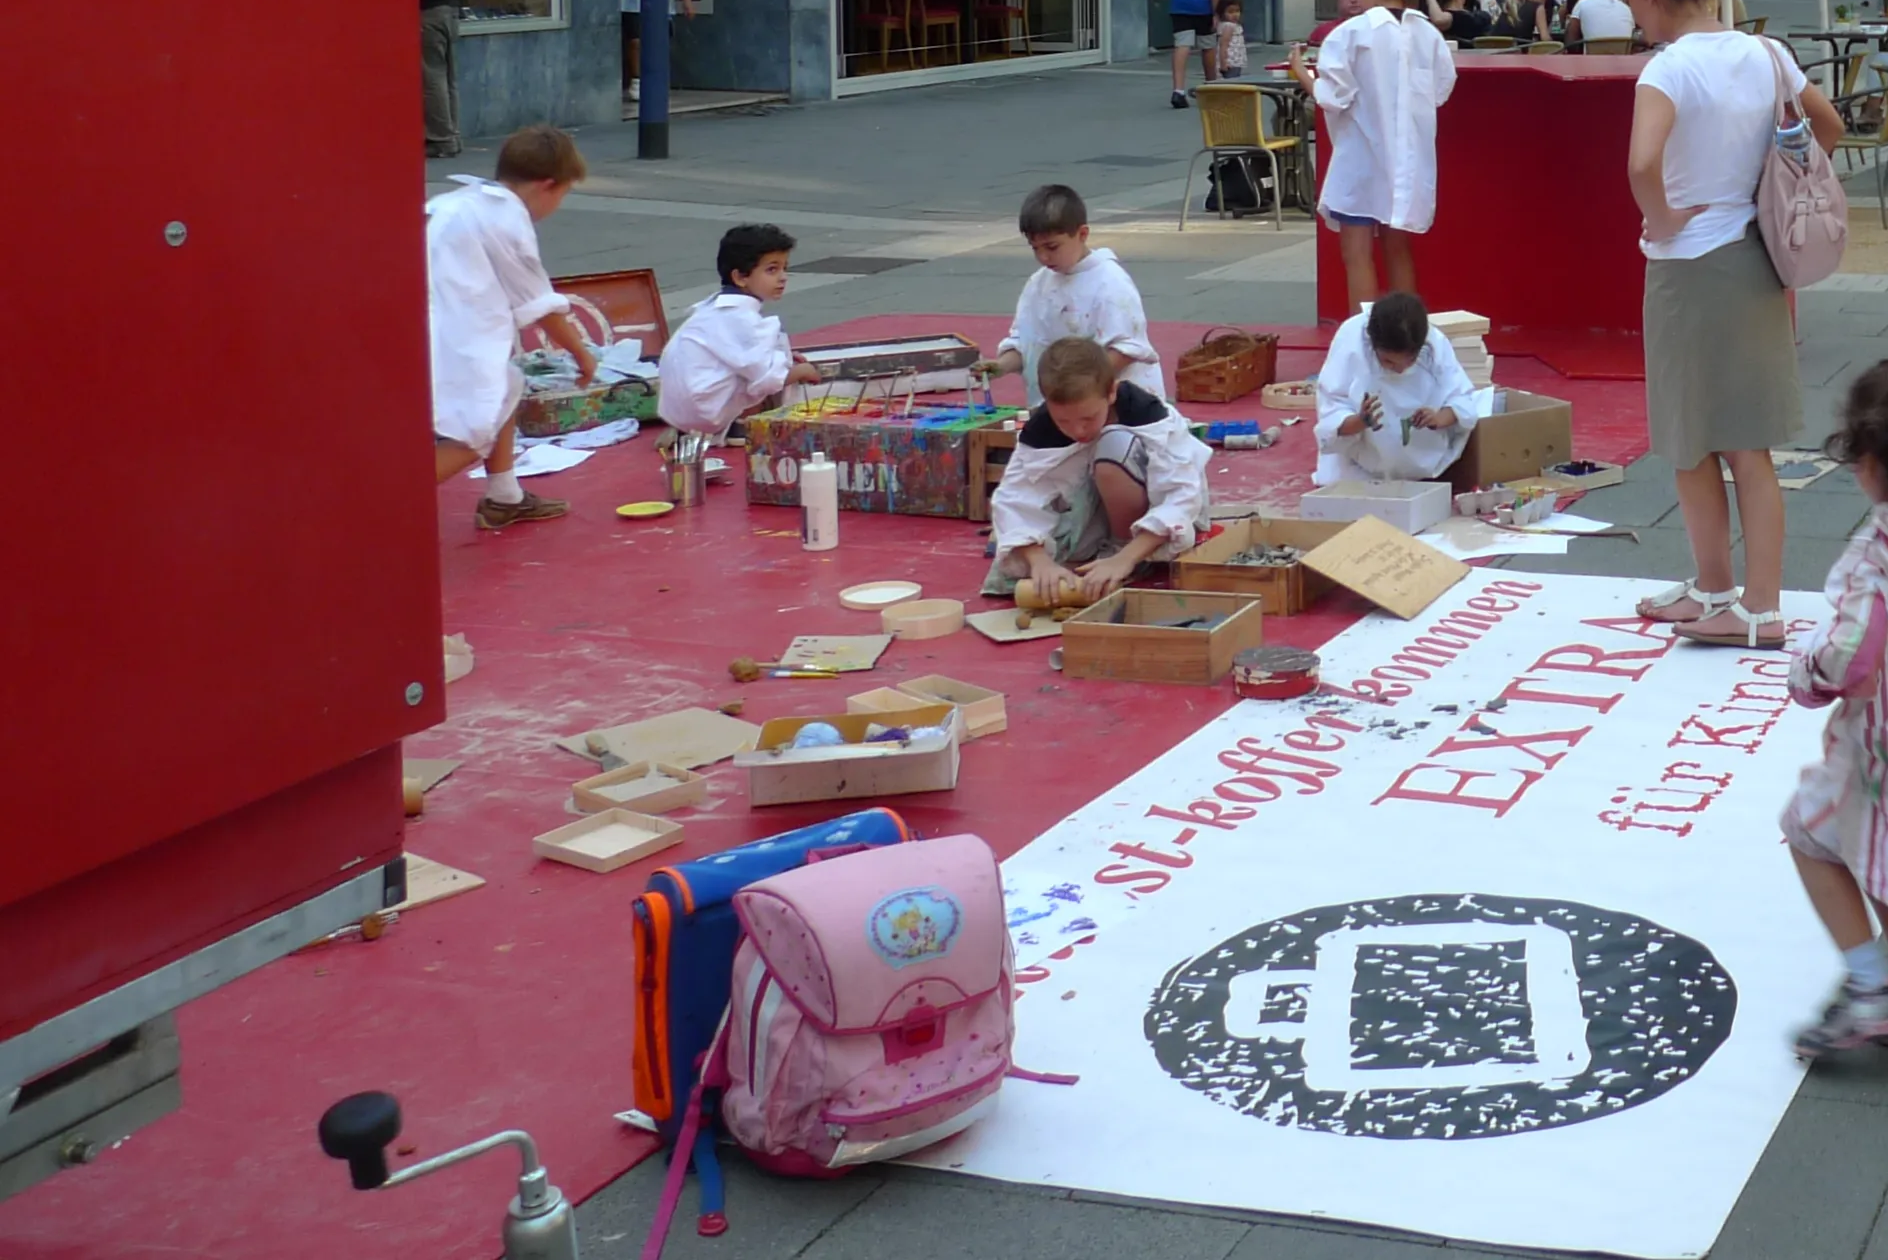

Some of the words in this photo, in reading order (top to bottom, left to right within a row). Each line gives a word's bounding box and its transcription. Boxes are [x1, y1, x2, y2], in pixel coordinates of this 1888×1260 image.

[1334, 578, 1543, 708] kommen
[1370, 616, 1681, 819] EXTRA
[1596, 760, 1735, 839] für
